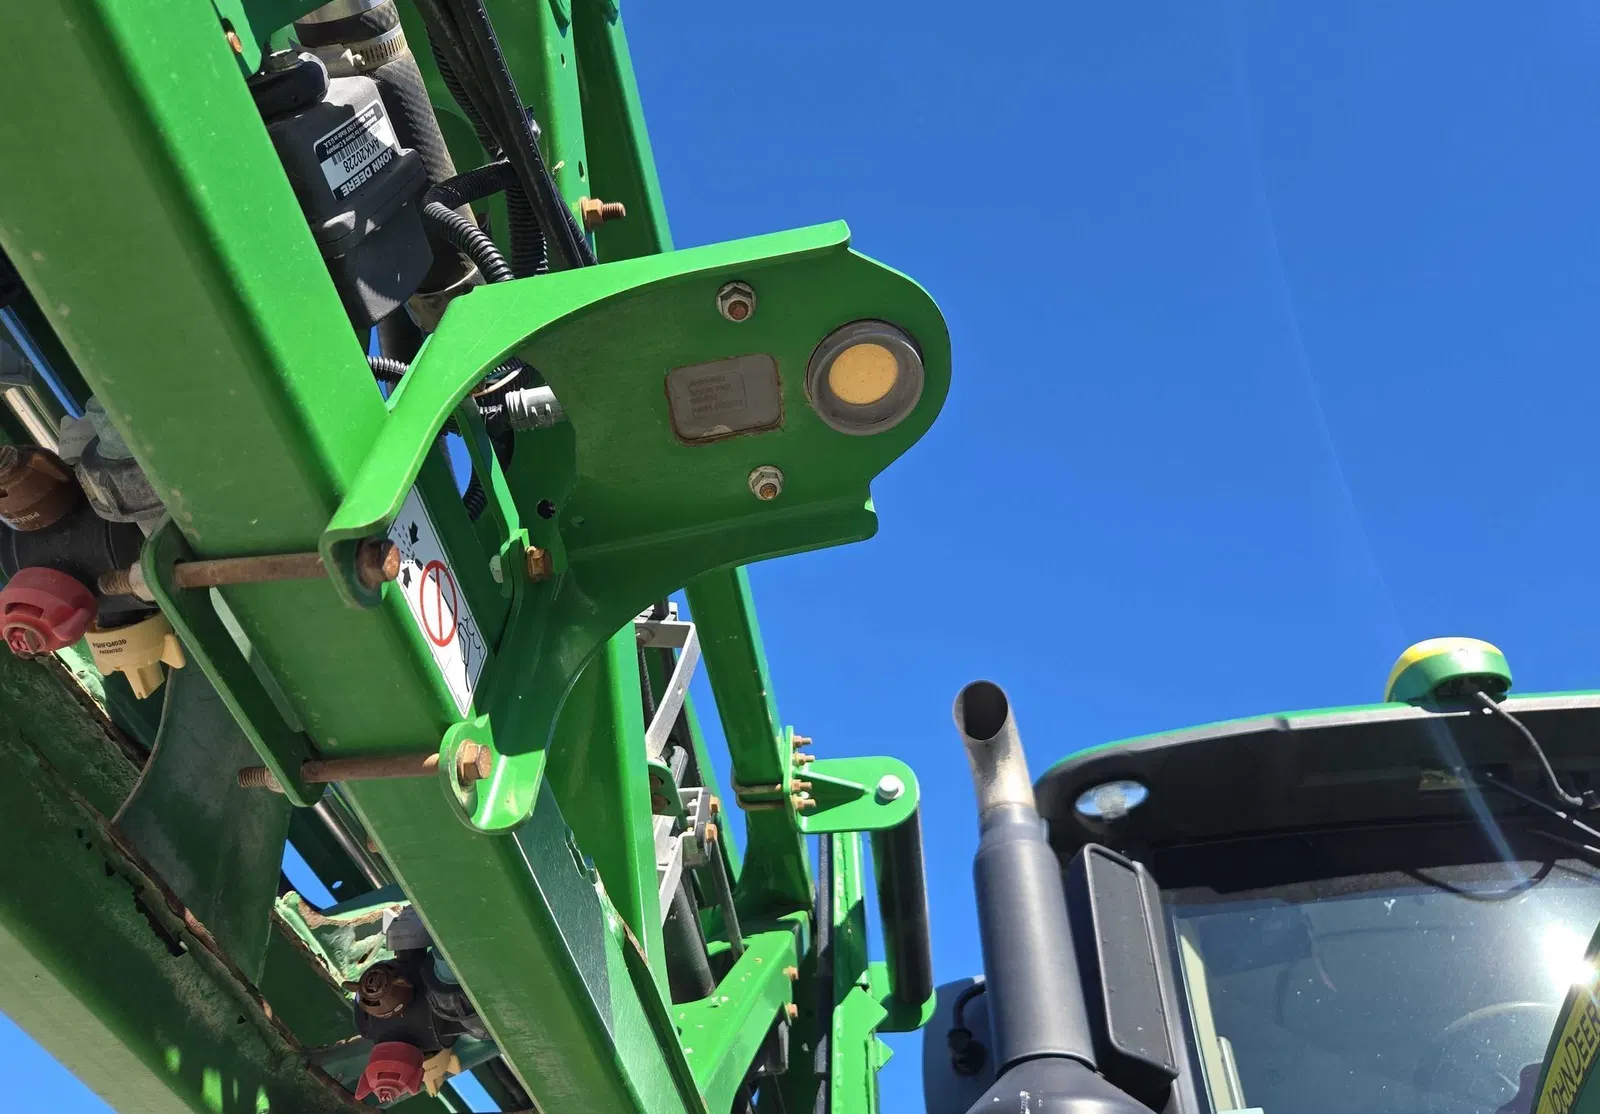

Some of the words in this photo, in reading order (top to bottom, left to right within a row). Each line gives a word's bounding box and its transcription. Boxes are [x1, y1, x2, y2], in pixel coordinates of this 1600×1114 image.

[342, 138, 380, 174] AKK20228
[371, 149, 393, 173] JOHN
[340, 168, 373, 197] DEERE
